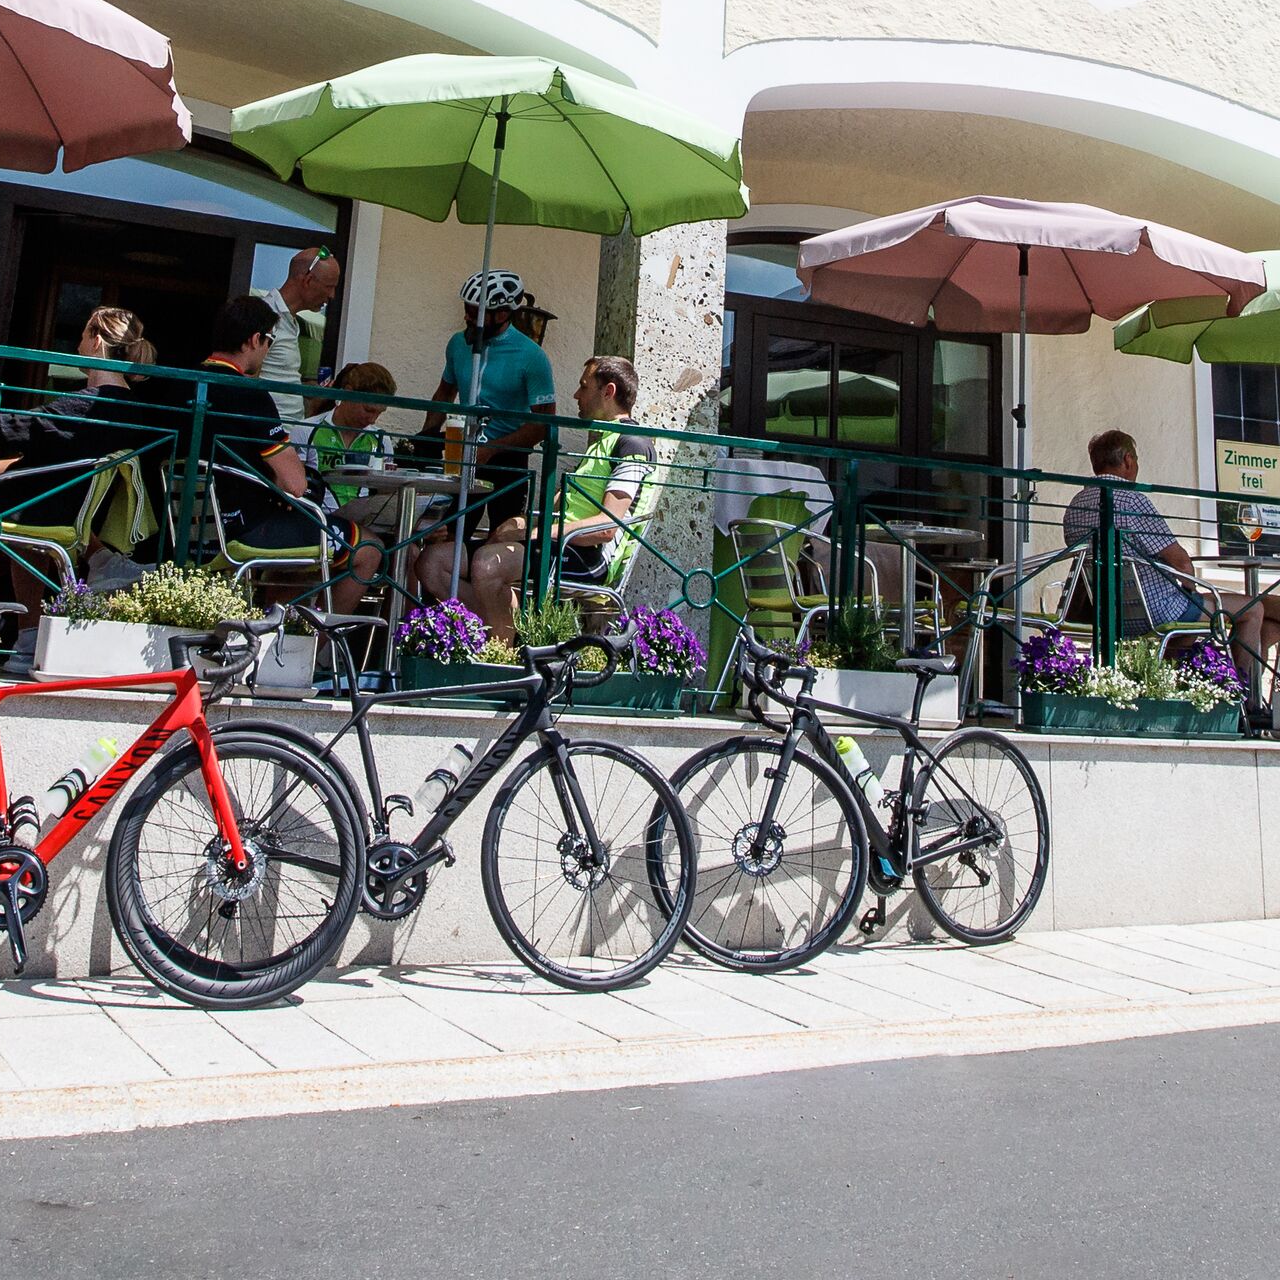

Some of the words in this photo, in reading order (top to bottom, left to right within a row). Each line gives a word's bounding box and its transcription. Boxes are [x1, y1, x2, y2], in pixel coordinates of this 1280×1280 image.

[1224, 449, 1278, 470] Zimmer
[1241, 472, 1264, 489] frei
[73, 728, 176, 821] CANYON
